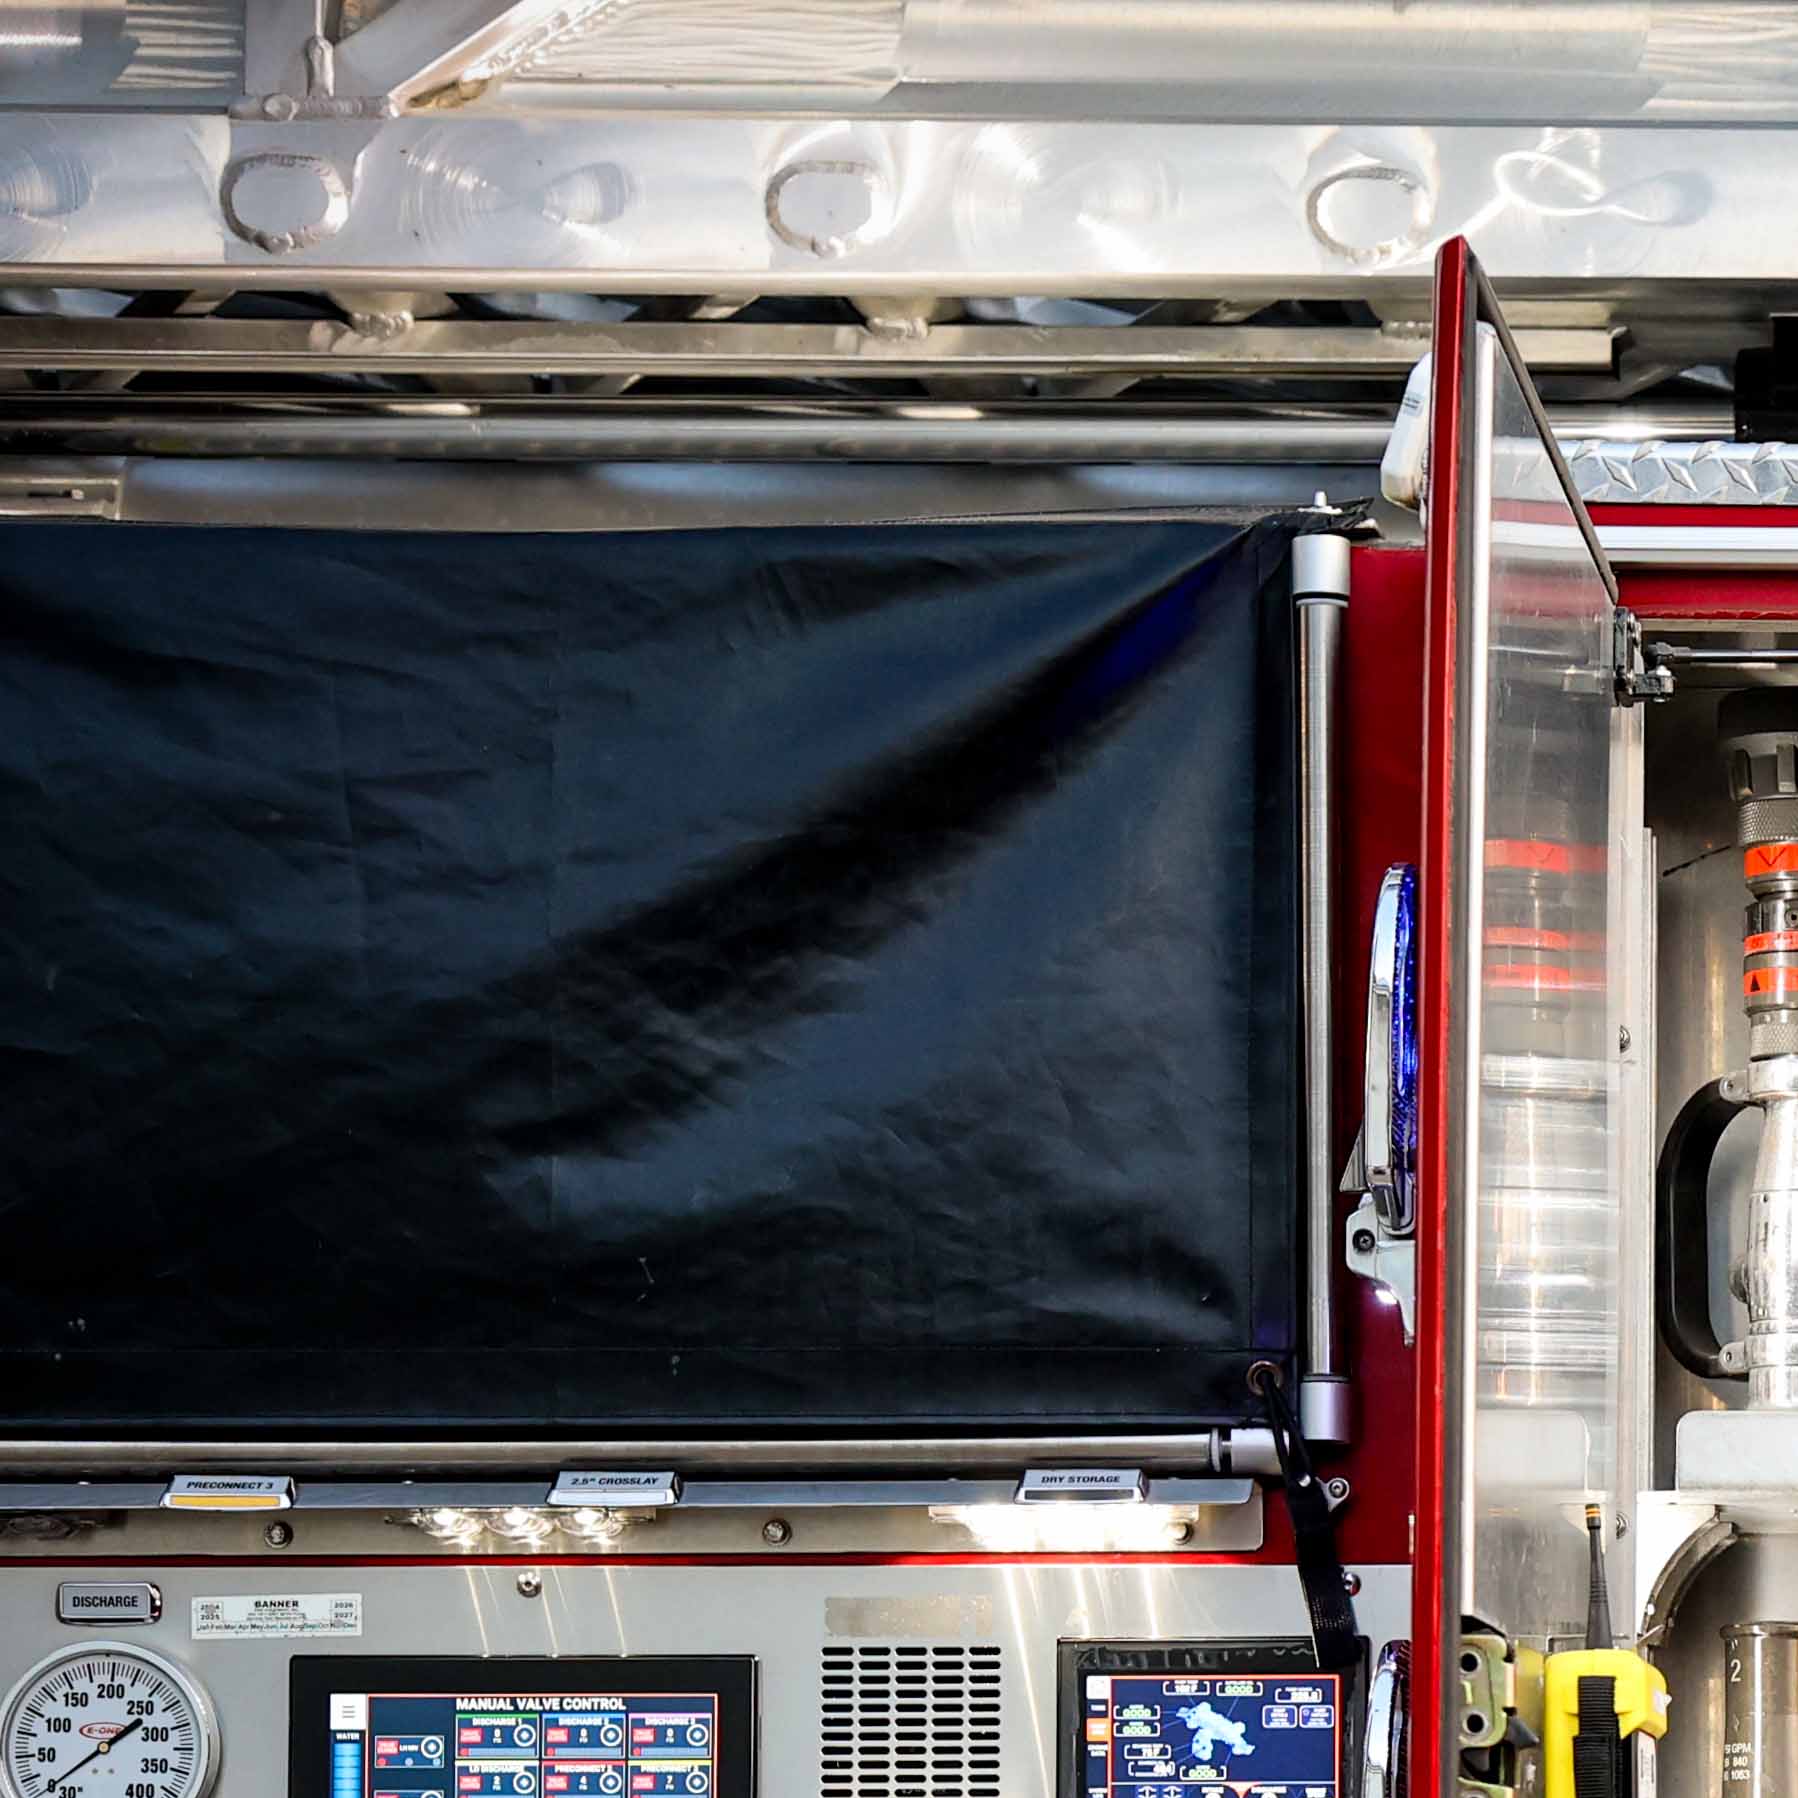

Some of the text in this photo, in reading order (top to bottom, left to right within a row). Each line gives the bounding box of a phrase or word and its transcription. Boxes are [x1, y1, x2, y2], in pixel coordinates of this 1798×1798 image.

[72, 1596, 138, 1607] DISCHARGE
[97, 1684, 124, 1699] 200
[64, 1693, 88, 1707] 150
[456, 1699, 626, 1710] MANUAL VALVE CONTROL
[127, 1701, 154, 1715] 250
[46, 1718, 71, 1732] 100
[142, 1728, 168, 1741] 300
[38, 1748, 55, 1762] 50
[141, 1759, 168, 1773] 350
[126, 1784, 154, 1798] 400
